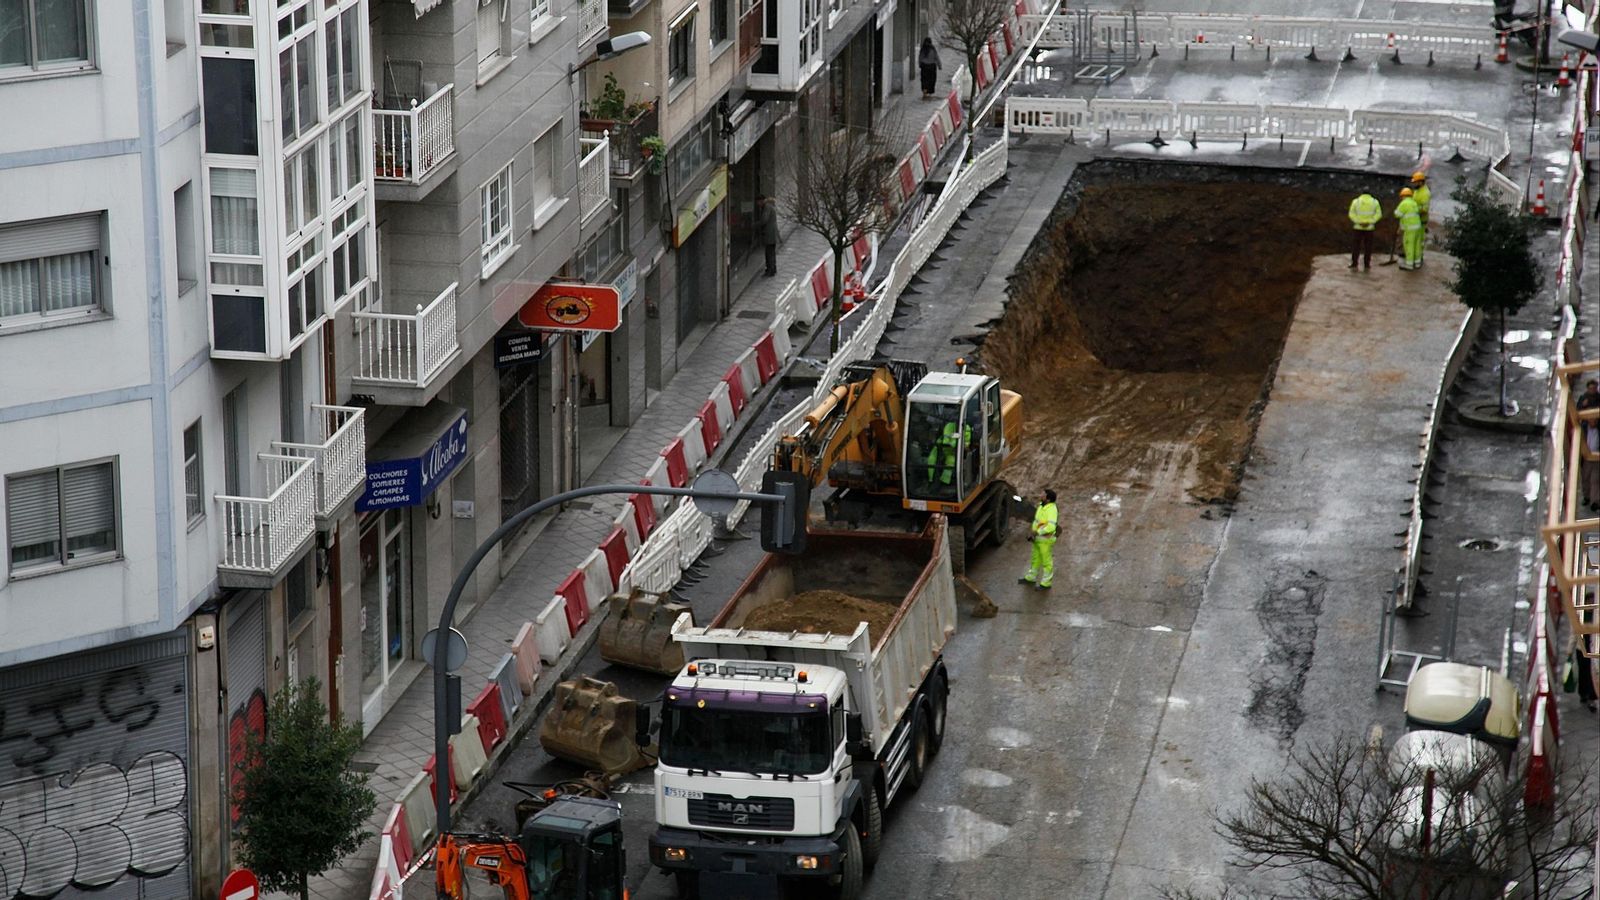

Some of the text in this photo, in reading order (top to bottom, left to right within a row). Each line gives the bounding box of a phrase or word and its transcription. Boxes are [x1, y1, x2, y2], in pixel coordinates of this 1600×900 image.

[511, 344, 529, 353] VENTA
[523, 349, 541, 358] MANO
[369, 469, 408, 480] COLCHONES
[372, 478, 405, 488] SOMIERES
[368, 495, 410, 505] ALMOHADAS
[718, 802, 762, 814] MAN
